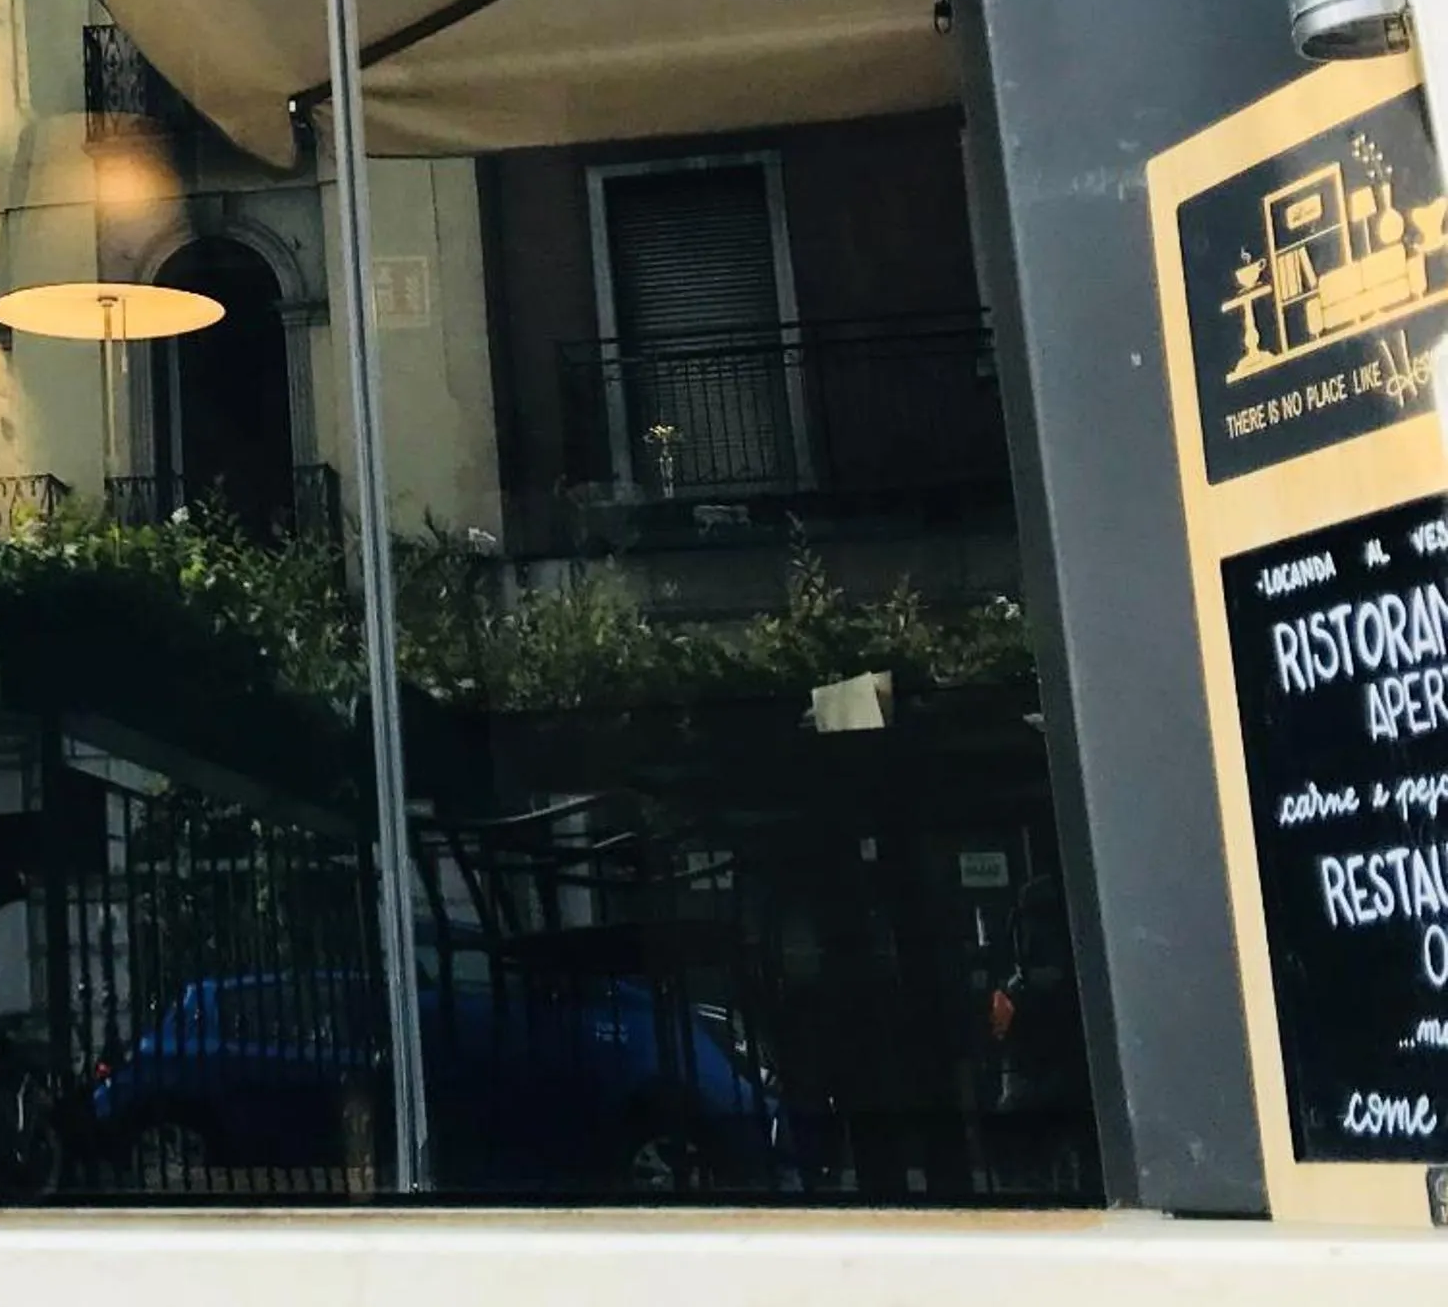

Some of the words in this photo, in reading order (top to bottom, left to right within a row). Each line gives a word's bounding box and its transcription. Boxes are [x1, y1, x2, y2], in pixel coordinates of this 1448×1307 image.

[1224, 404, 1267, 440] THERE
[1267, 400, 1280, 425] IS
[1281, 390, 1303, 420] NO
[1305, 373, 1349, 412] PLACE
[1351, 359, 1383, 394] LIKE
[1365, 538, 1391, 568] AL
[1363, 660, 1448, 741] APER
[1279, 781, 1360, 825] carne
[1343, 1091, 1438, 1136] come
